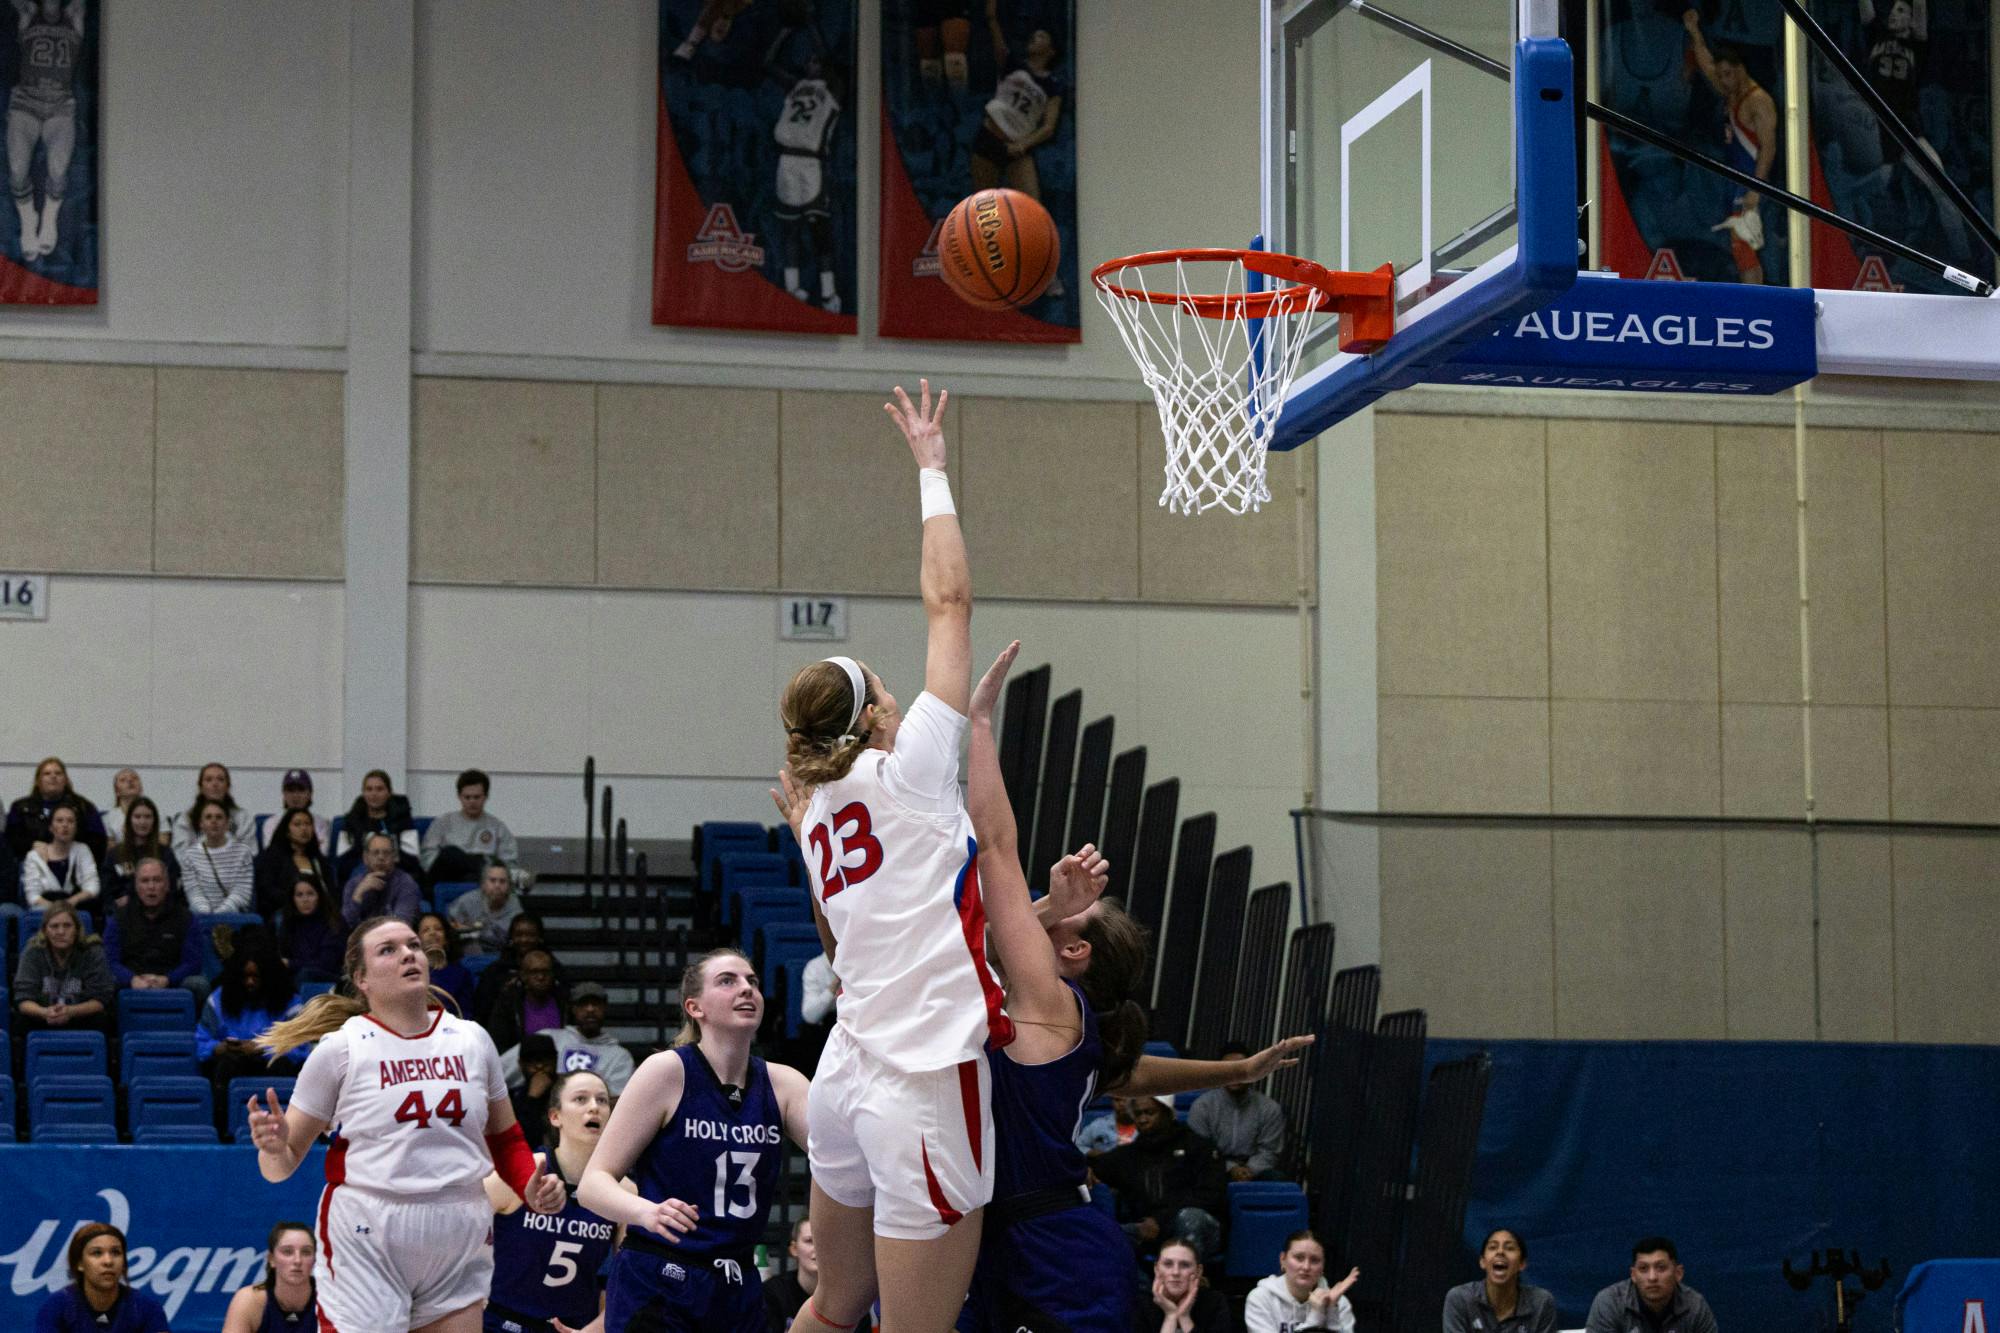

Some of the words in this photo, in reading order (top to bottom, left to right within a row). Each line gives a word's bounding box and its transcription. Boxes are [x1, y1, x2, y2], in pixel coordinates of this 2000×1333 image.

[31, 38, 72, 68] 21
[974, 193, 1007, 273] Wilson
[1493, 309, 1775, 350] AUEAGLES
[1460, 372, 1754, 391] #AUEAGLES
[3, 579, 34, 606] 16
[792, 602, 834, 626] 117
[808, 801, 884, 904] 23
[380, 1054, 469, 1090] AMERICAN
[394, 1088, 468, 1129] 44
[684, 1117, 729, 1142] HOLY
[731, 1123, 781, 1145] CROS
[714, 1150, 761, 1219] 13
[523, 1211, 566, 1235] HOLY
[567, 1219, 614, 1240] CROSS
[0, 1188, 270, 1324] Wegm
[542, 1240, 584, 1287] 5
